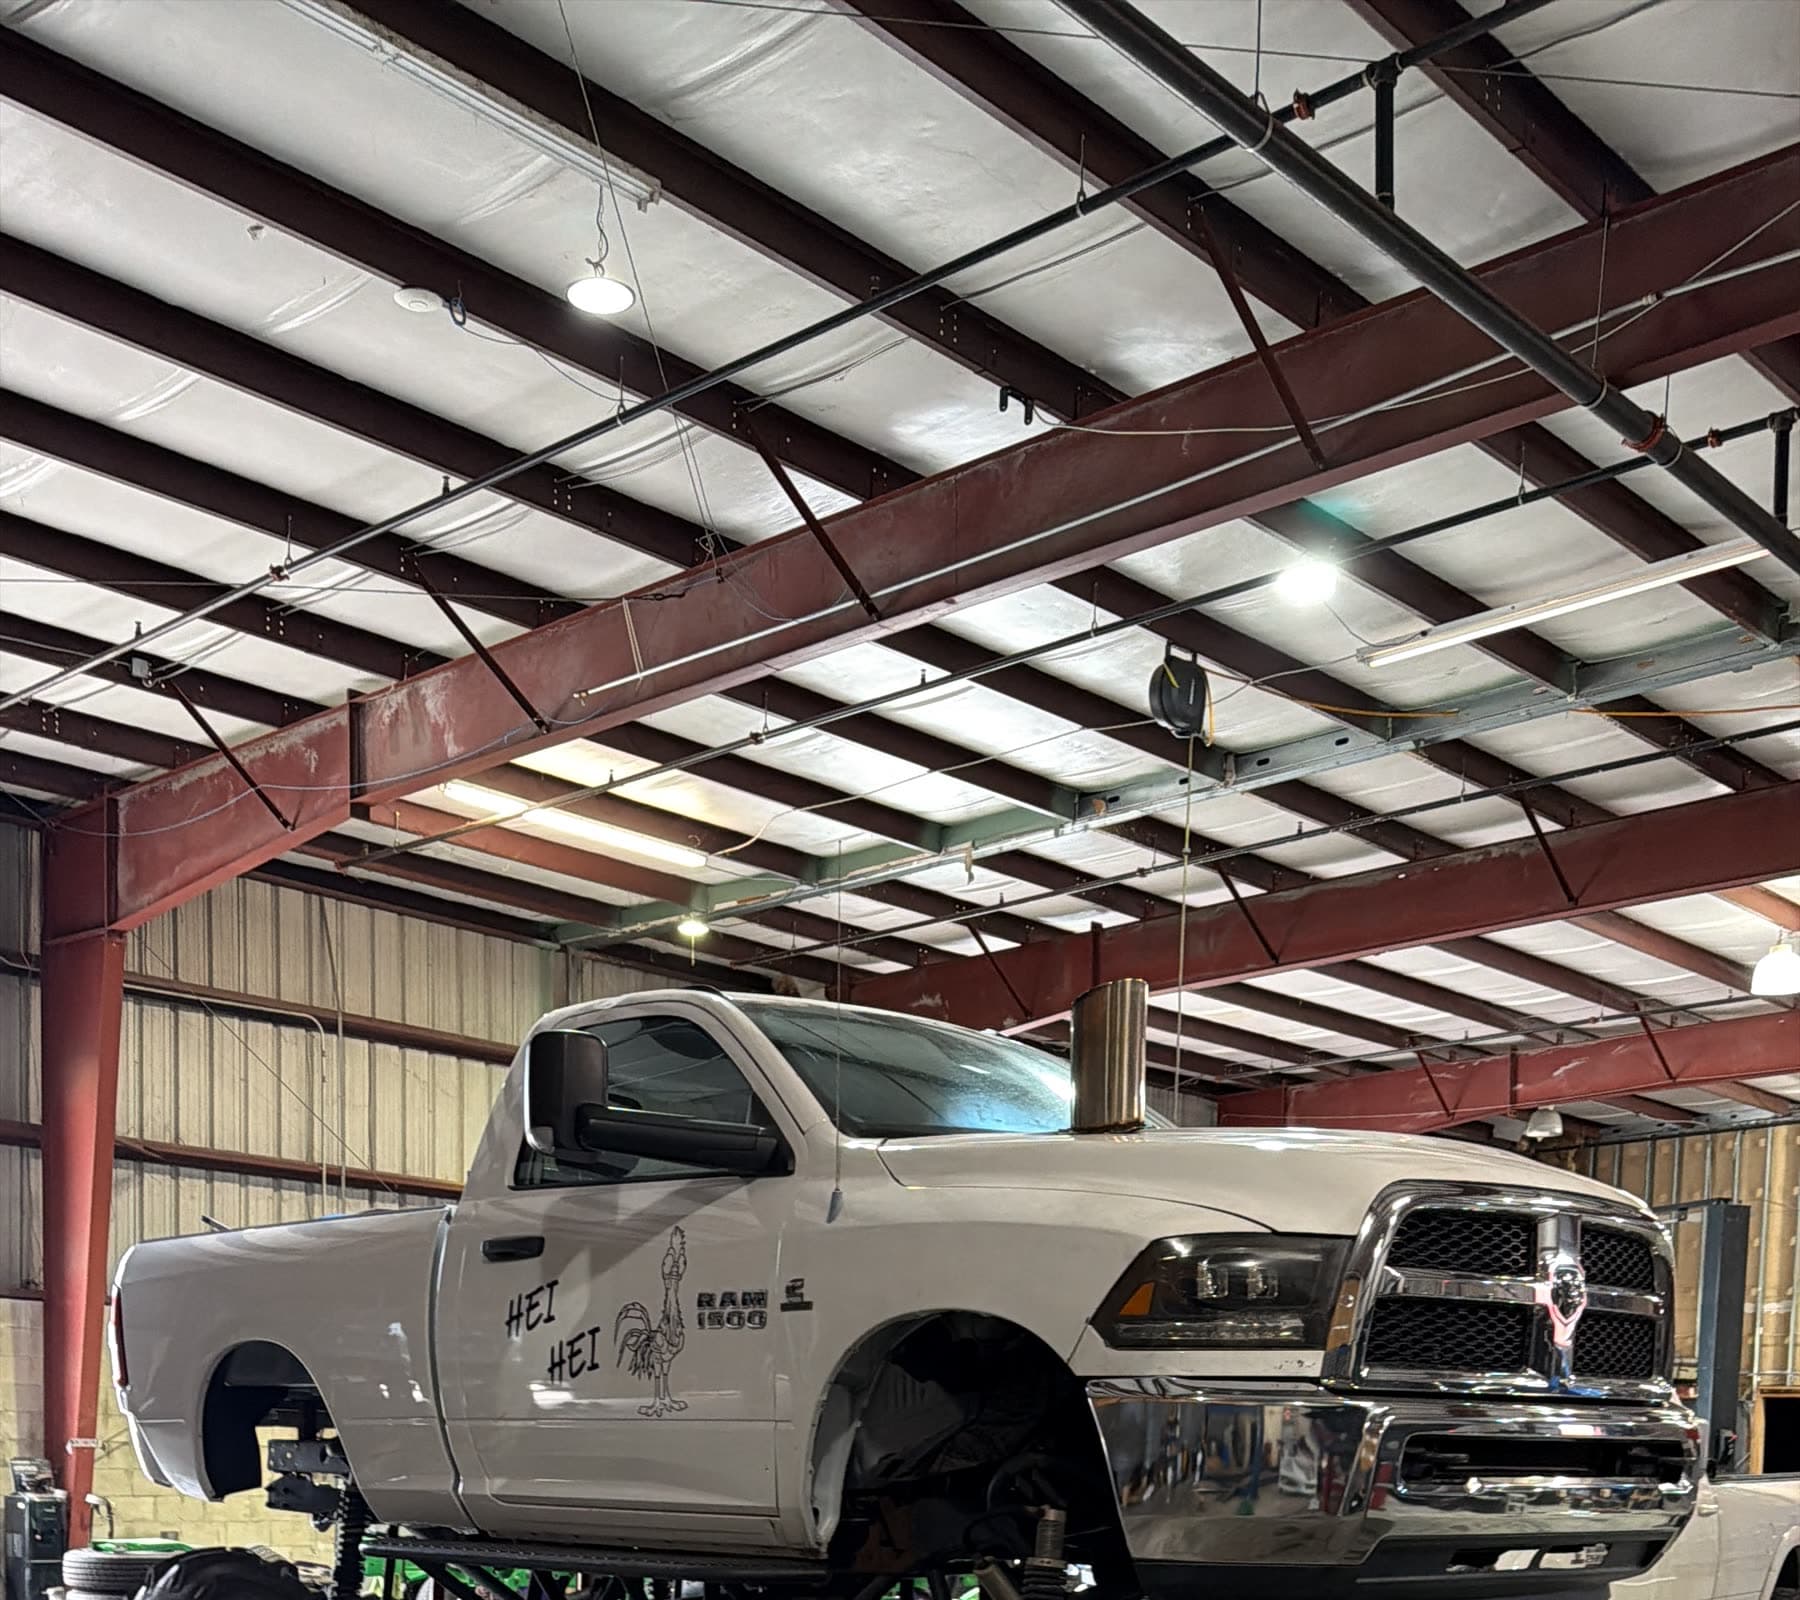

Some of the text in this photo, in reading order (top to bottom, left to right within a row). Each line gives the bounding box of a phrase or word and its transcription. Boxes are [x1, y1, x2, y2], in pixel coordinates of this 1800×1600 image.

[505, 1280, 559, 1338] HEI
[697, 1291, 768, 1310] RAM
[697, 1310, 768, 1330] 1500
[547, 1327, 601, 1384] HEI
